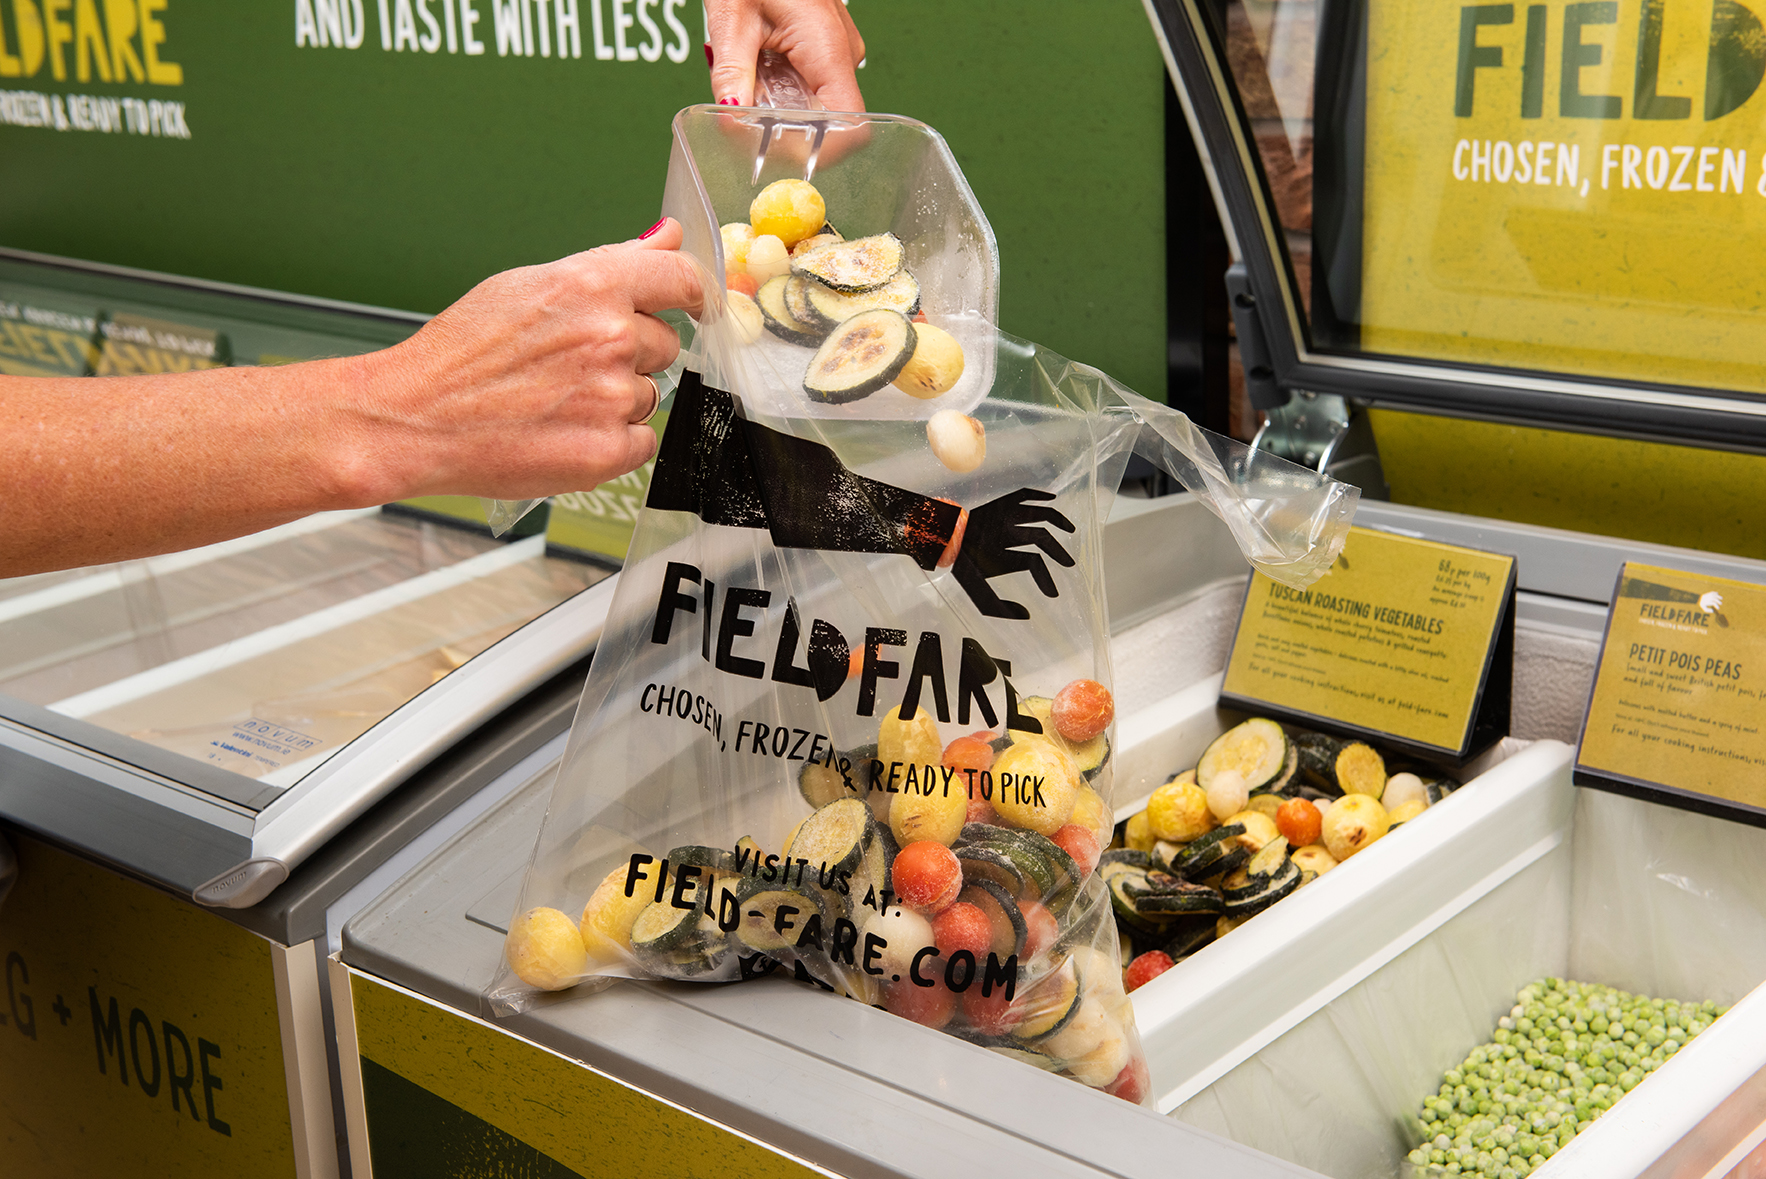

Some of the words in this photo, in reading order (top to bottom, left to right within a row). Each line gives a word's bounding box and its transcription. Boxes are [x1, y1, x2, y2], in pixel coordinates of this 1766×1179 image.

[295, 0, 364, 49] AND
[376, 0, 484, 55] TASTE
[494, 0, 582, 60] WITH
[592, 0, 690, 64] LESS
[1454, 0, 1766, 122] FIELD
[1452, 139, 1590, 198] CHOSEN,
[1601, 144, 1747, 194] FROZEN
[1269, 582, 1313, 605] TUSCAN
[1314, 592, 1371, 619] ROASTING
[1373, 605, 1444, 635] VEGETABLES
[1640, 603, 1710, 628] FIELDFARE
[650, 560, 1044, 735] FIELDFARE
[1629, 643, 1666, 665] PETIT
[1668, 650, 1701, 672] POIS
[1704, 657, 1742, 680] PEAS
[1623, 675, 1638, 683] and
[1640, 677, 1654, 688] full
[1656, 681, 1665, 692] of
[1666, 683, 1693, 695] flavour
[1627, 662, 1647, 673] Small
[1649, 669, 1664, 677] and
[1666, 673, 1687, 682] sweet
[1689, 675, 1714, 687] British
[1716, 683, 1736, 692] petit
[243, 721, 314, 749] novum
[639, 682, 727, 753] CHOSEN,
[734, 720, 841, 774] FROZEN
[837, 757, 858, 792] &
[868, 759, 955, 799] READY
[962, 768, 993, 801] TO
[1001, 772, 1047, 809] PICK
[1611, 723, 1625, 734] For
[1628, 729, 1640, 737] all
[1641, 733, 1660, 743] your
[1664, 738, 1695, 753] cooking
[1698, 745, 1751, 764] instructions,
[211, 870, 247, 894] novum
[734, 845, 808, 886] VISIT
[818, 860, 853, 897] US
[861, 884, 903, 918] AT:
[624, 853, 1018, 1001] FIELD-FARE.COM
[0, 950, 37, 1041] G
[88, 985, 232, 1138] MORE
